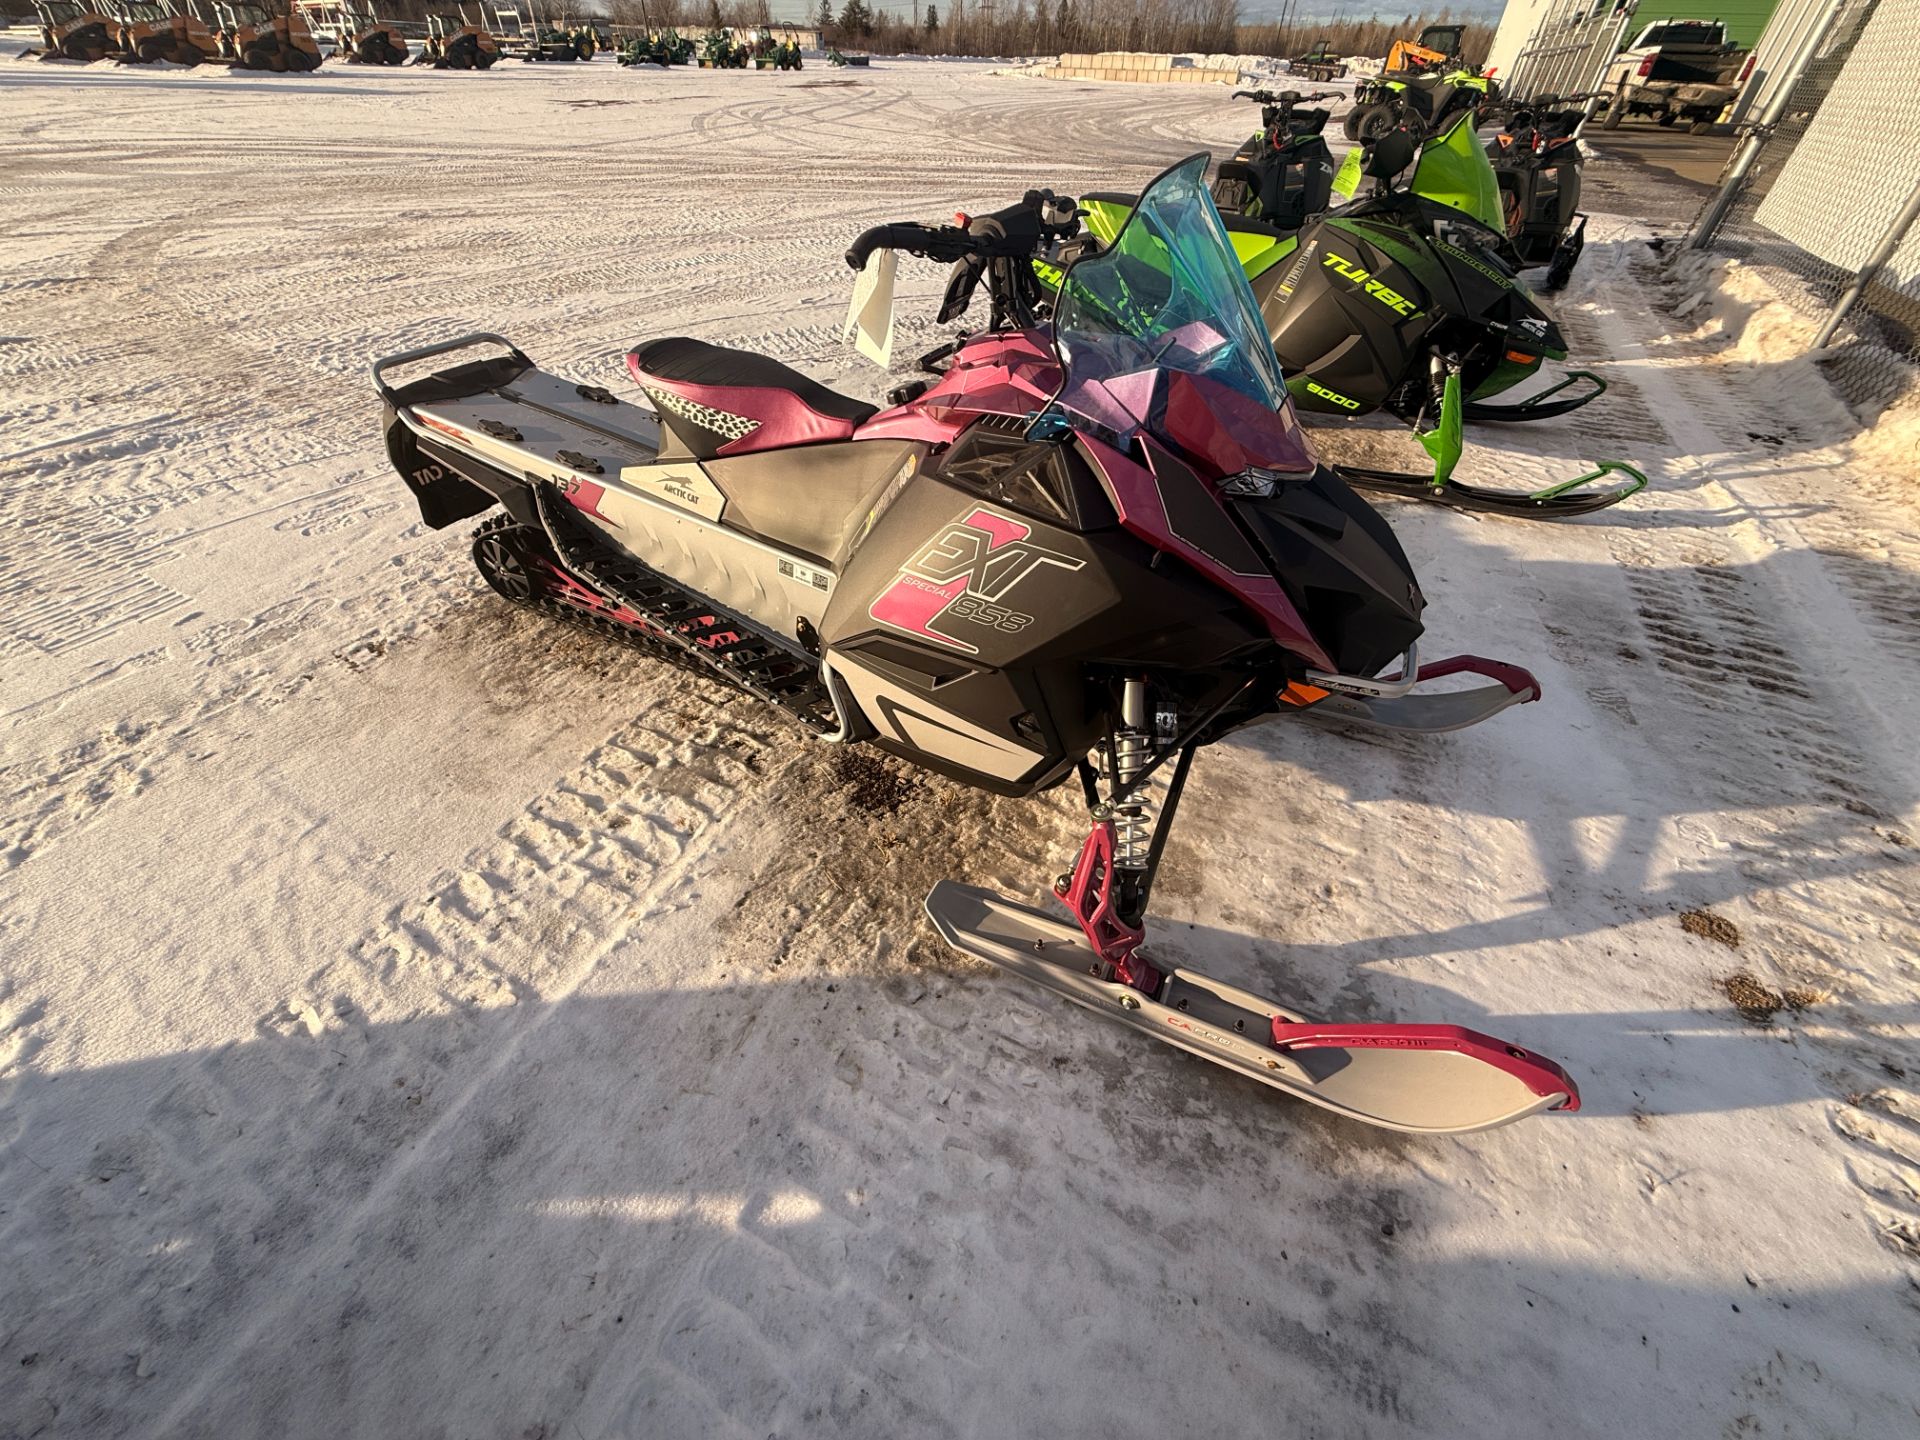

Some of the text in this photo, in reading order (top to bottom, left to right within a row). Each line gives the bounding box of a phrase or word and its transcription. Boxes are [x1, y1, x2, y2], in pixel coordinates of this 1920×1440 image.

[148, 20, 172, 32] CASE
[1306, 382, 1361, 410] 9000
[550, 473, 582, 496] 137
[663, 482, 701, 505] ARCTIC CAT
[898, 521, 1088, 603] EXT
[901, 575, 953, 600] SPECIAL
[947, 596, 1036, 634] 858
